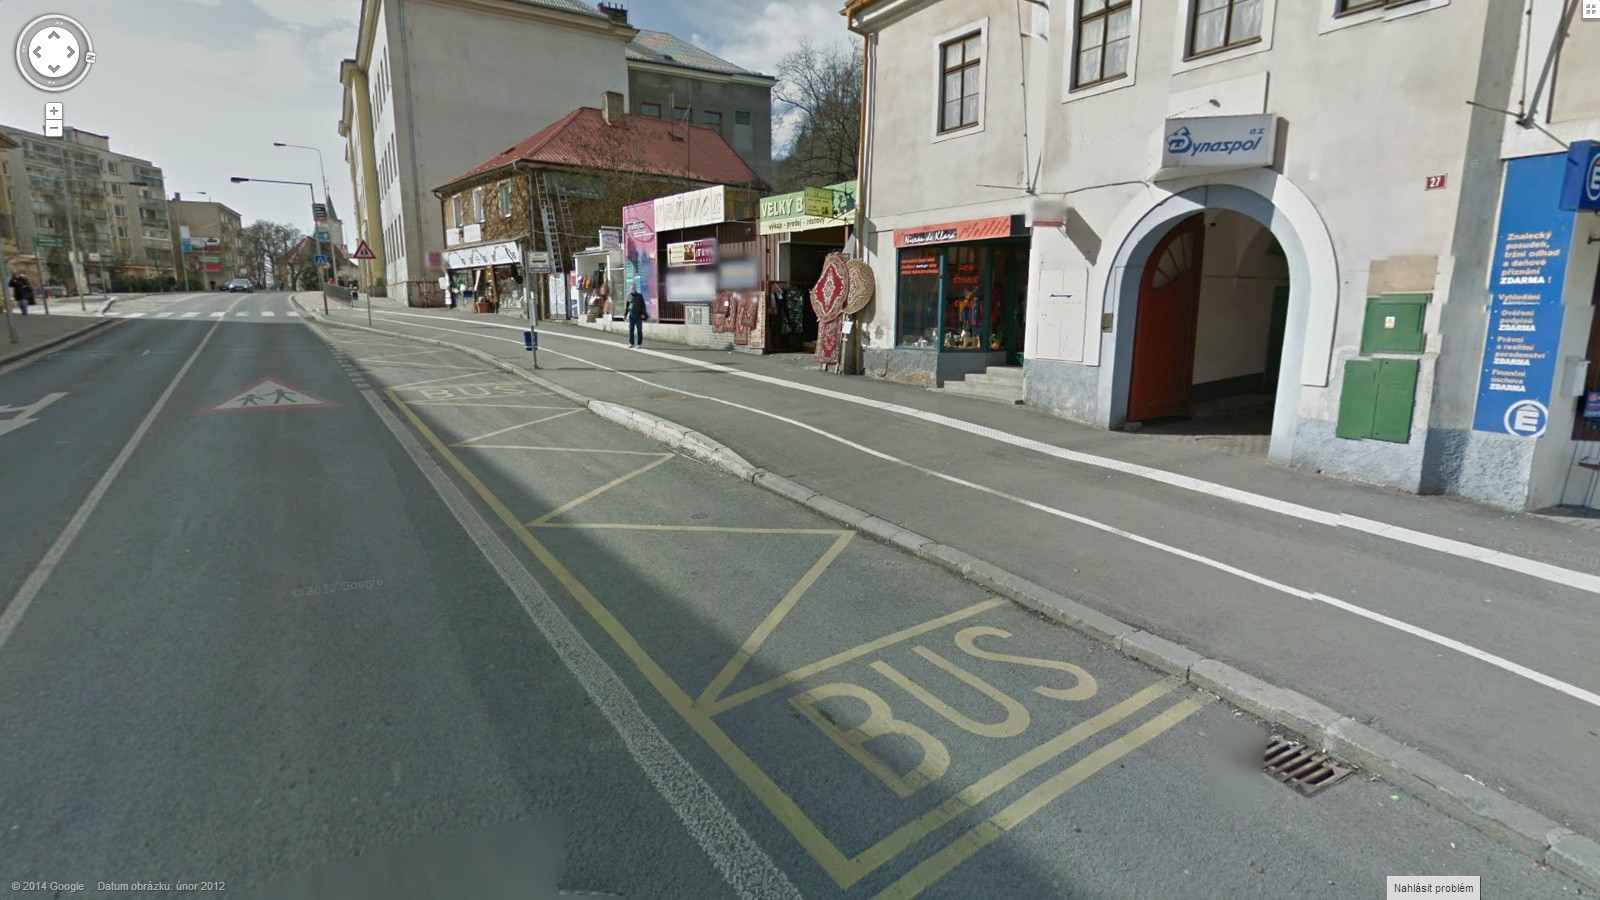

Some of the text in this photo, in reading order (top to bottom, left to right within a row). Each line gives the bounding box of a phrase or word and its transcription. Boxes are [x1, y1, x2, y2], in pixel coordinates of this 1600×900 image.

[1165, 127, 1262, 156] Dynaspol
[1429, 176, 1442, 188] 27
[656, 193, 722, 224] TRŽNICE
[761, 195, 793, 218] VELKÝ
[786, 218, 802, 229] prodej
[1507, 231, 1553, 241] Znalecký
[1505, 240, 1550, 251] posudek,
[1504, 249, 1561, 258] tržní odhad
[1511, 258, 1547, 267] daňové
[1501, 267, 1540, 277] přiznání
[1499, 276, 1545, 285] ZDARMA
[1498, 294, 1541, 302] Vyhledání
[1501, 309, 1535, 317] Ověření
[1500, 317, 1534, 325] podpisů
[1498, 324, 1536, 332] ZDARMA
[1494, 351, 1546, 360] poradenství
[1493, 358, 1531, 367] ZDARMA
[1491, 368, 1526, 378] Finanční
[1490, 376, 1524, 385] úschova
[1489, 383, 1527, 392] ZDARMA
[419, 385, 527, 400] BUS
[788, 625, 1098, 799] BUS
